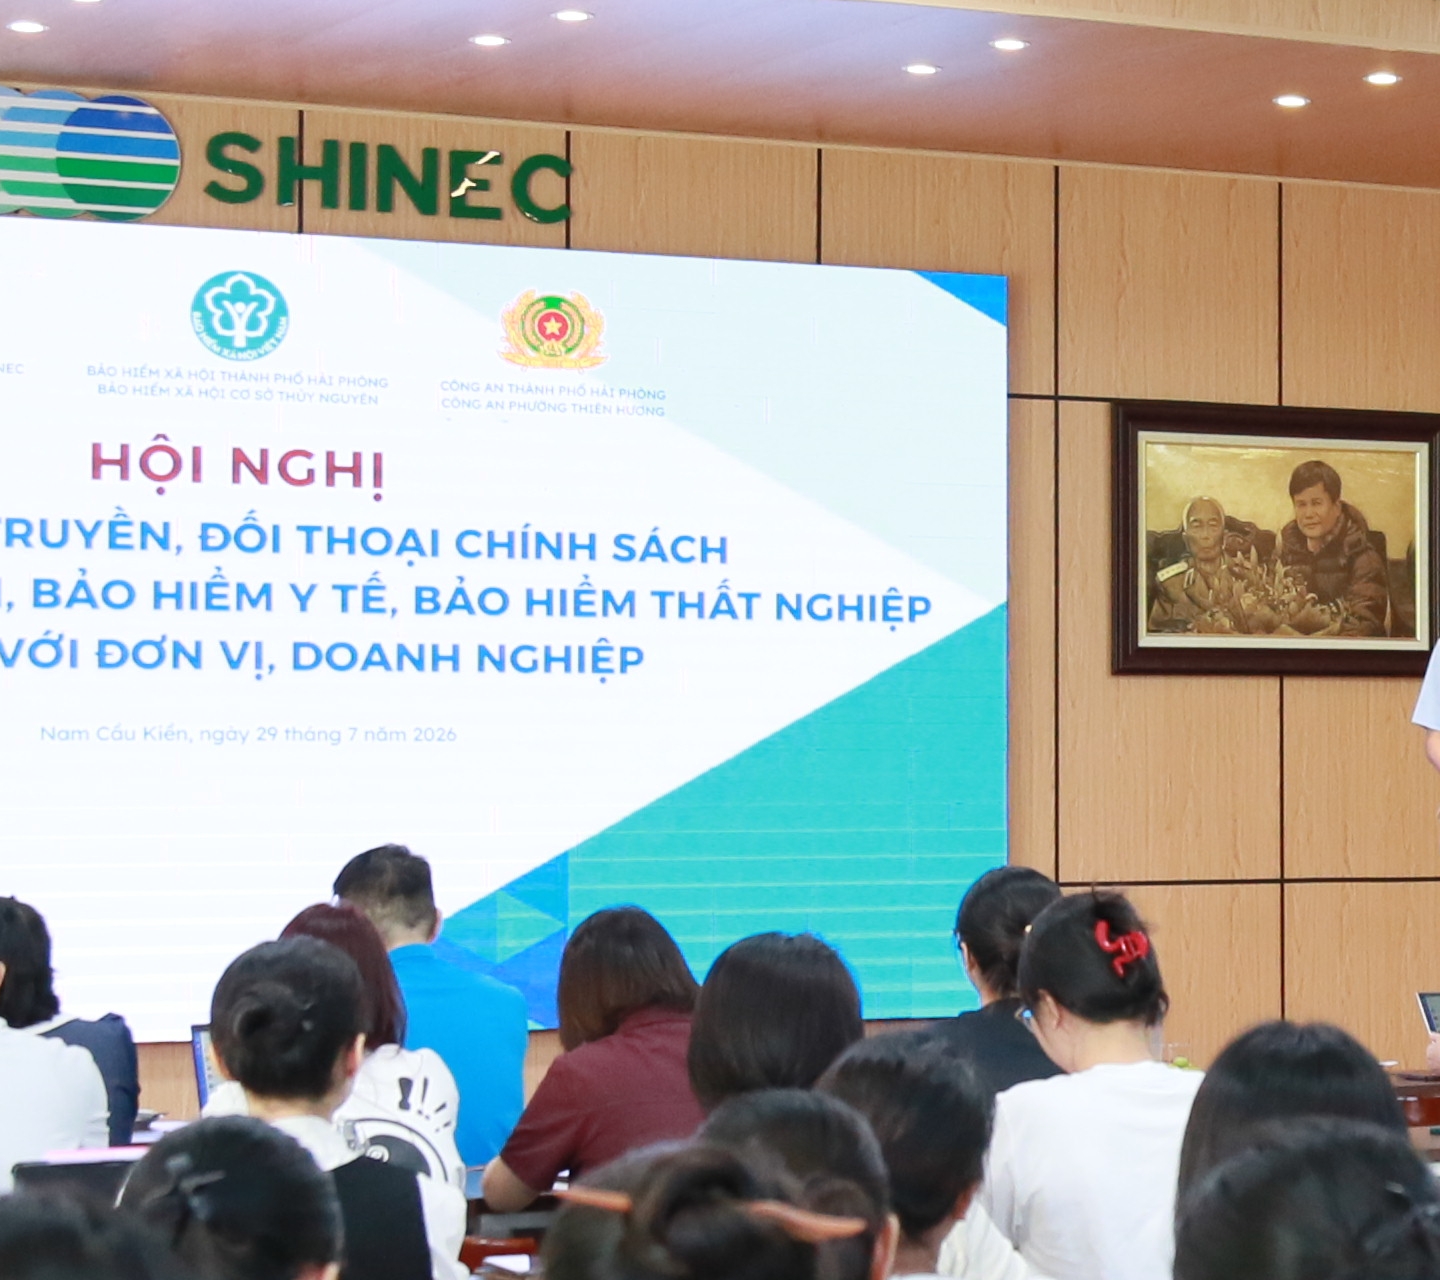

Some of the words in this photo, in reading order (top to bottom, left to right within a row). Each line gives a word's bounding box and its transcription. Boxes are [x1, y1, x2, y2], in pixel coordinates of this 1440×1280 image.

[203, 131, 572, 224] SHINEC
[86, 362, 118, 378] BẢO
[121, 363, 161, 379] HIỂM
[164, 367, 184, 380] XÃ
[187, 367, 215, 382] HỘI
[219, 370, 270, 383] THÀNH
[338, 375, 389, 389] PHÒNG
[97, 381, 129, 396] BẢO
[175, 385, 194, 398] XÃ
[198, 386, 225, 401] HỘI
[439, 378, 481, 393] CÔNG
[484, 383, 504, 393] AN
[507, 382, 555, 395] THÀNH
[441, 397, 482, 410] CÔNG
[485, 399, 505, 410] AN
[92, 431, 201, 495] HỘI
[232, 448, 382, 501] NGHỊ
[198, 510, 280, 554] ĐỐI
[296, 525, 439, 568] THOẠI
[455, 523, 596, 561] CHÍNH
[612, 527, 727, 564] SÁCH
[32, 568, 136, 610] BẢO
[153, 566, 272, 612] HIỂM
[290, 584, 317, 612] Y
[332, 571, 397, 618] TẾ,
[415, 576, 509, 616] BẢO
[526, 574, 635, 618] HIỂM
[650, 579, 761, 620] THẤT
[776, 587, 931, 630] NGHIỆP
[95, 635, 202, 670] ĐƠN
[219, 641, 275, 682] VỊ,
[293, 642, 460, 672] DOANH
[478, 637, 644, 684] NGHIỆP
[40, 726, 89, 742] Nam
[95, 724, 136, 742] Cầu
[199, 729, 250, 746] ngày
[256, 726, 278, 742] 29
[284, 727, 342, 746] tháng
[348, 727, 358, 741] 7
[364, 727, 407, 742] năm
